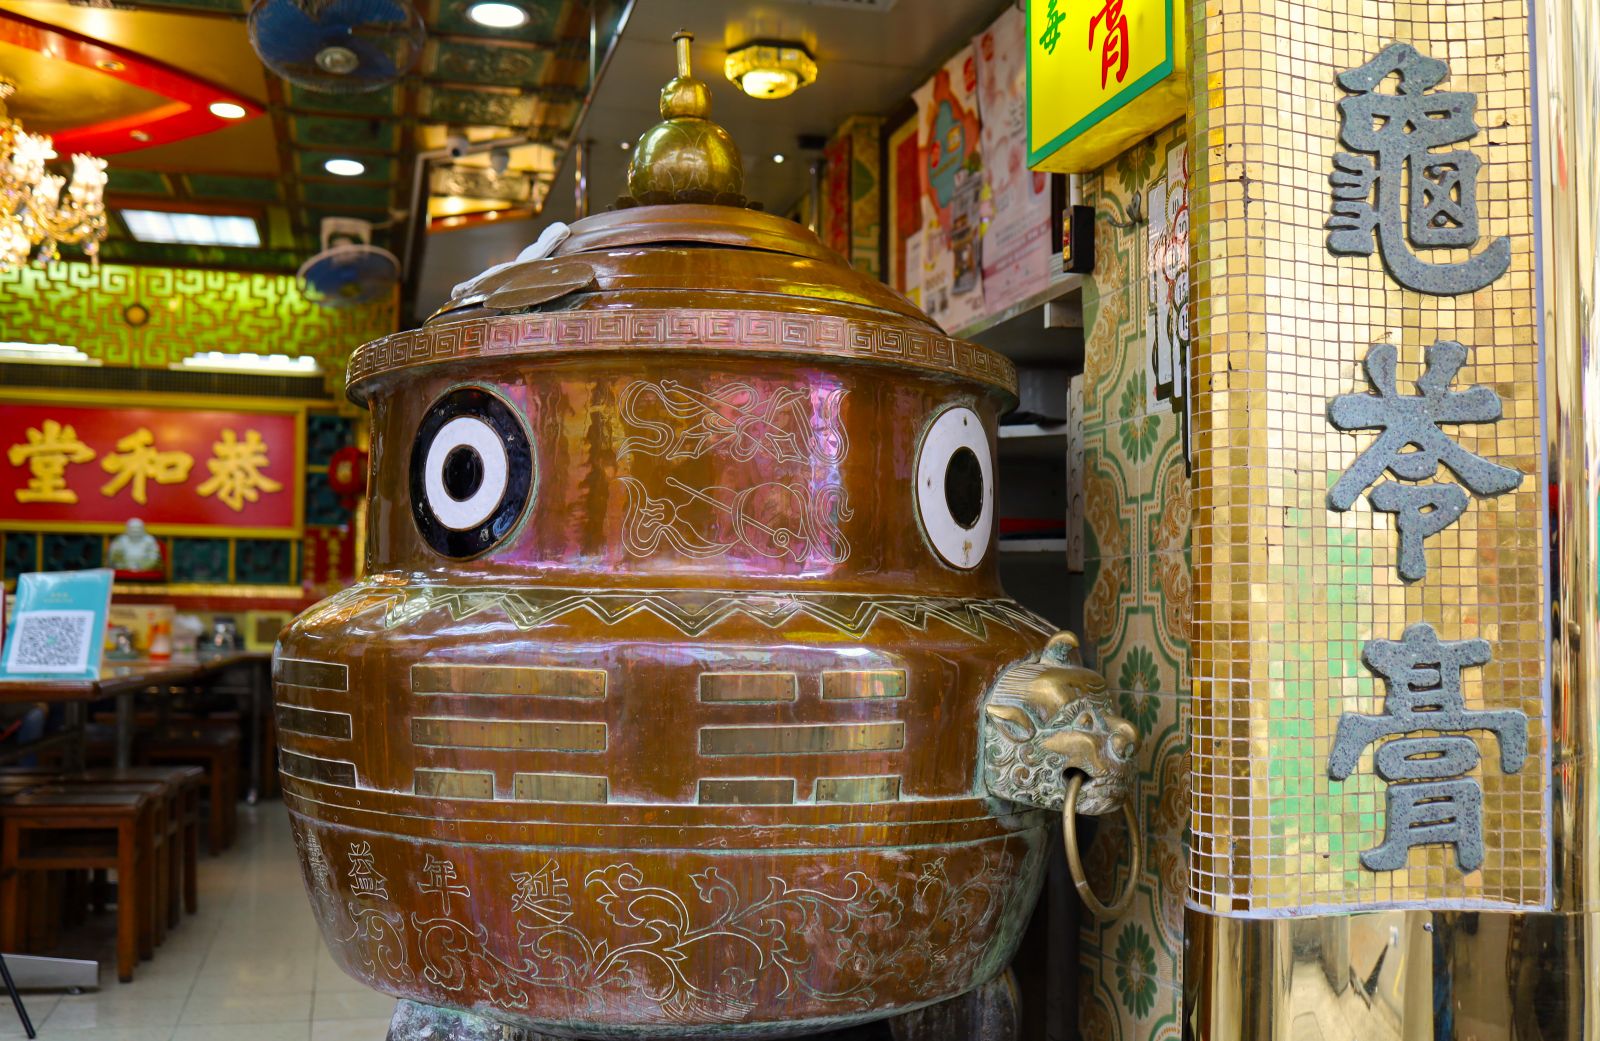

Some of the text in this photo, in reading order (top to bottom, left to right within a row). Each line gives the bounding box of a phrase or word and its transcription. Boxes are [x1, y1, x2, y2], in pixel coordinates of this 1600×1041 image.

[7, 418, 284, 512] 恭和堂
[1326, 41, 1529, 873] 龜苓膏
